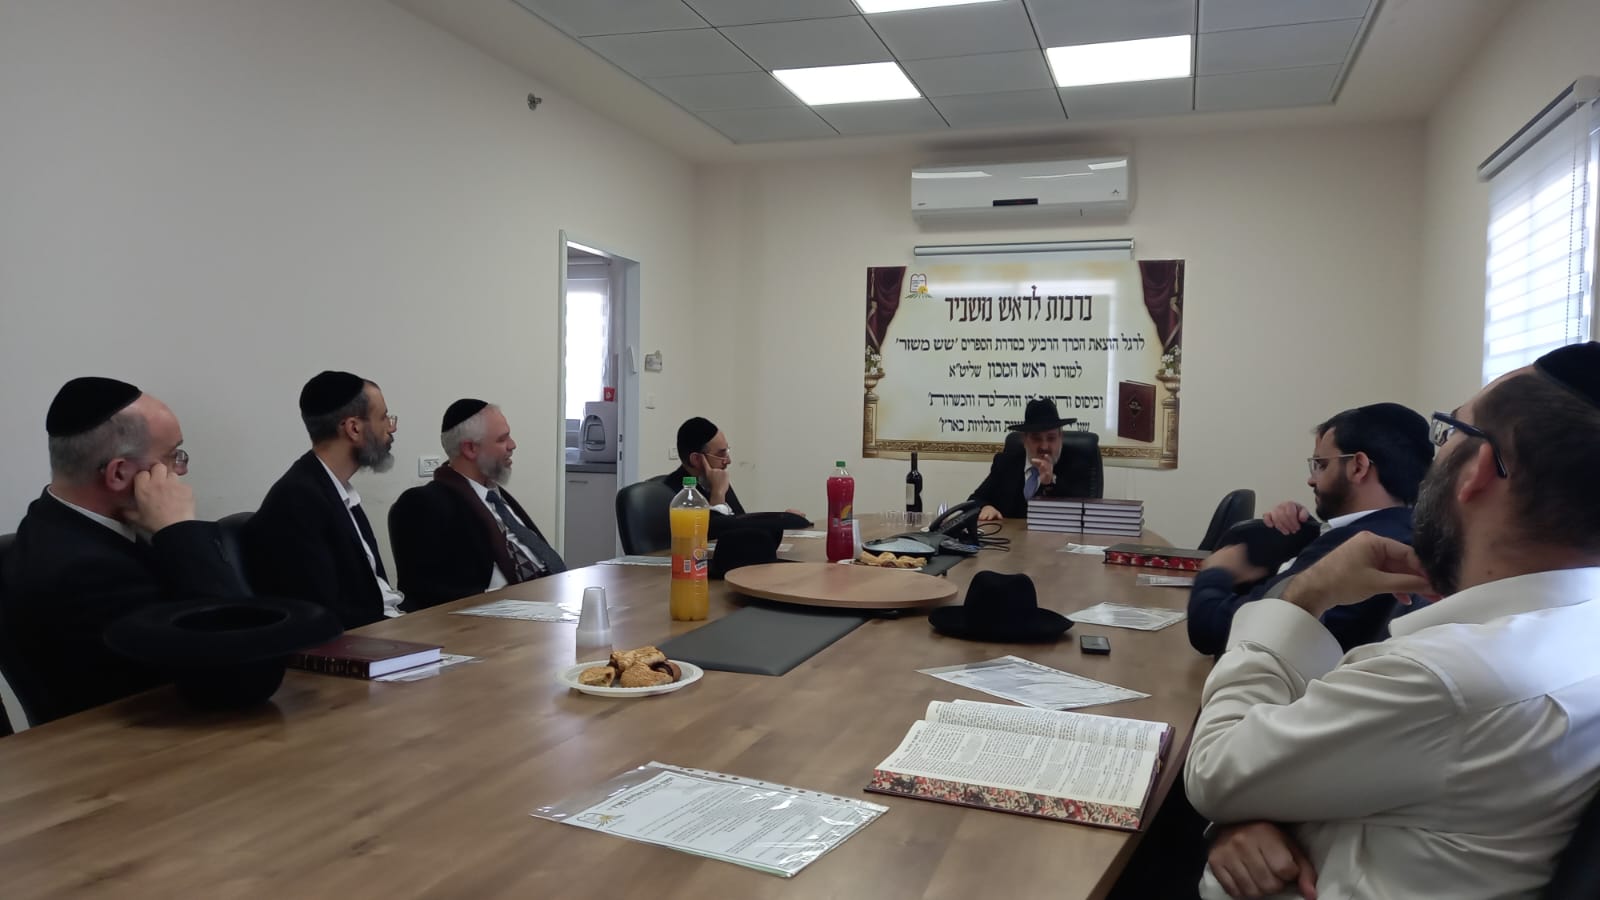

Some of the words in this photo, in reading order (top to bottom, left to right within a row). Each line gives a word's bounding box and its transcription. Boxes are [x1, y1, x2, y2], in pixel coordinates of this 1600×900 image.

[998, 285, 1041, 322] לראש
[961, 337, 993, 352] הספרים
[994, 336, 1026, 353] בסדרת
[1027, 337, 1060, 353] הרביעי
[1062, 337, 1087, 352] הכרך
[1088, 336, 1120, 352] הוצאת
[1121, 332, 1146, 352] לרגל
[987, 361, 1019, 380] המכון
[1022, 361, 1048, 379] ראש
[1052, 360, 1083, 379] למורנו
[967, 415, 1002, 433] התלויות
